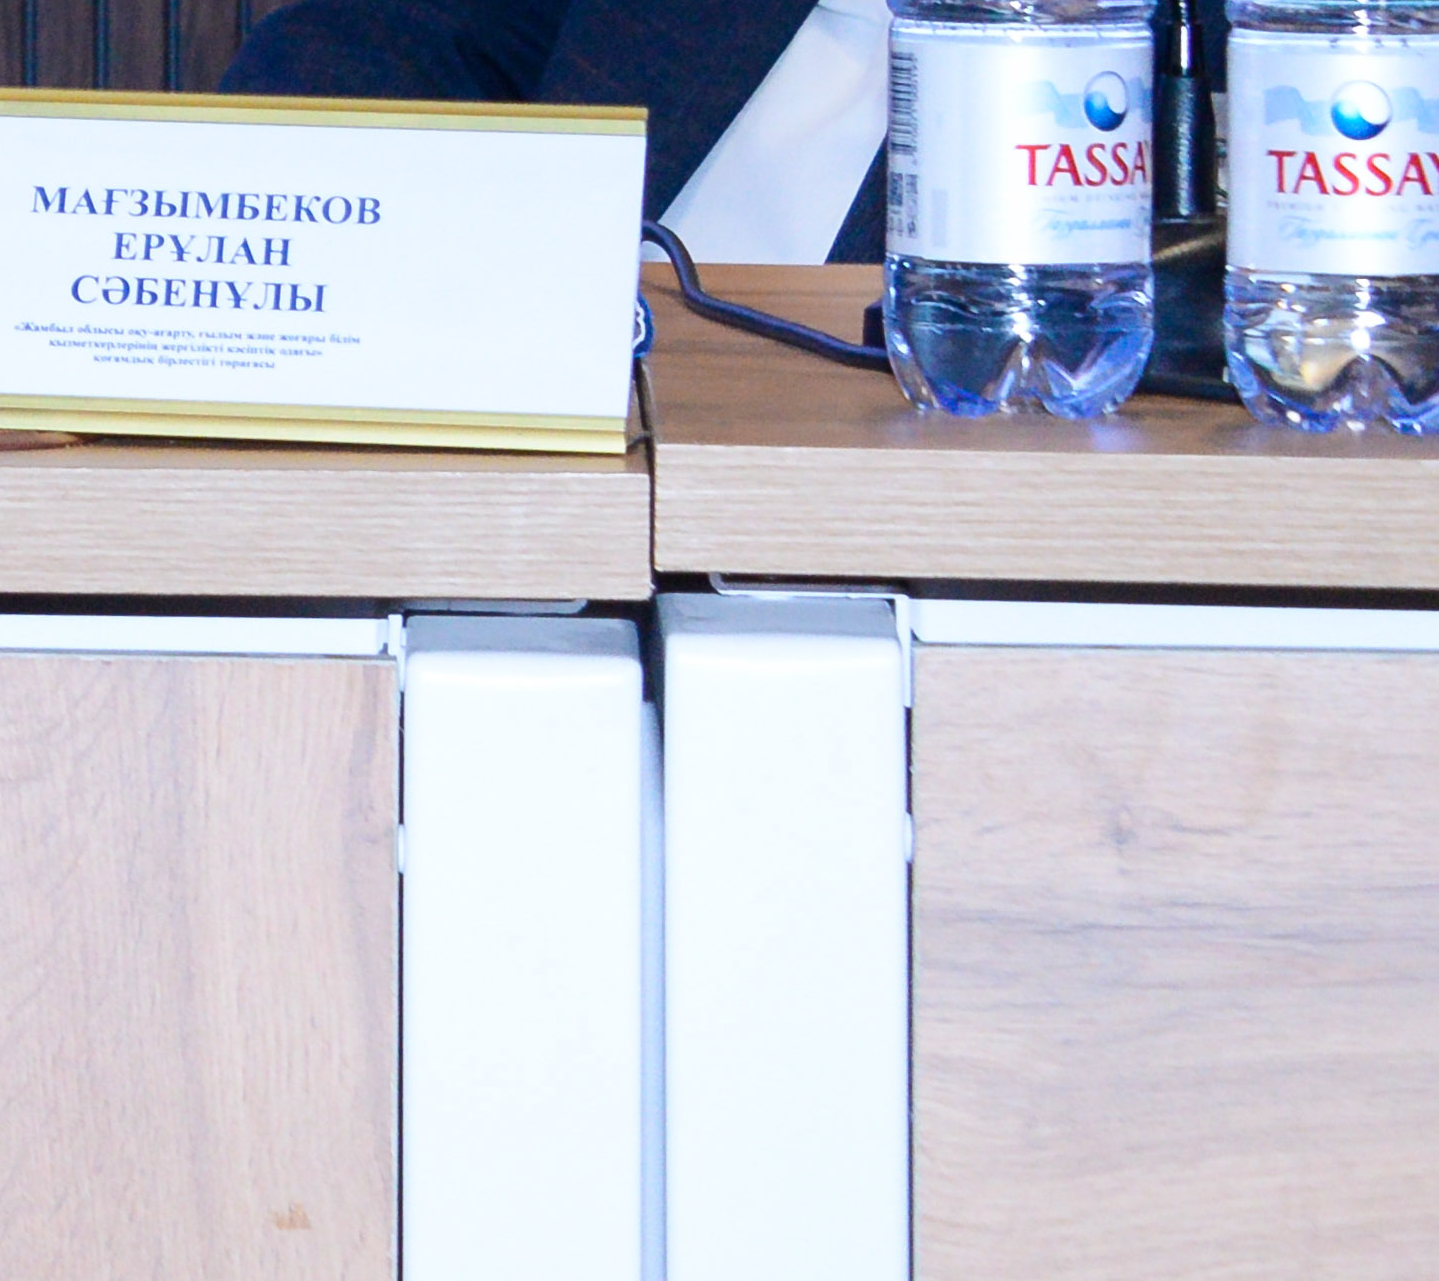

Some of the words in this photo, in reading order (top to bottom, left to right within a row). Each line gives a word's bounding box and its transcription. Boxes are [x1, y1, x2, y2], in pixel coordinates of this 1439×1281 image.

[32, 185, 381, 225] МАҒЗЫМБЕКОВ
[113, 231, 291, 267] ЕРҰЛАН
[70, 274, 327, 313] СӘБЕНҰЛЫ
